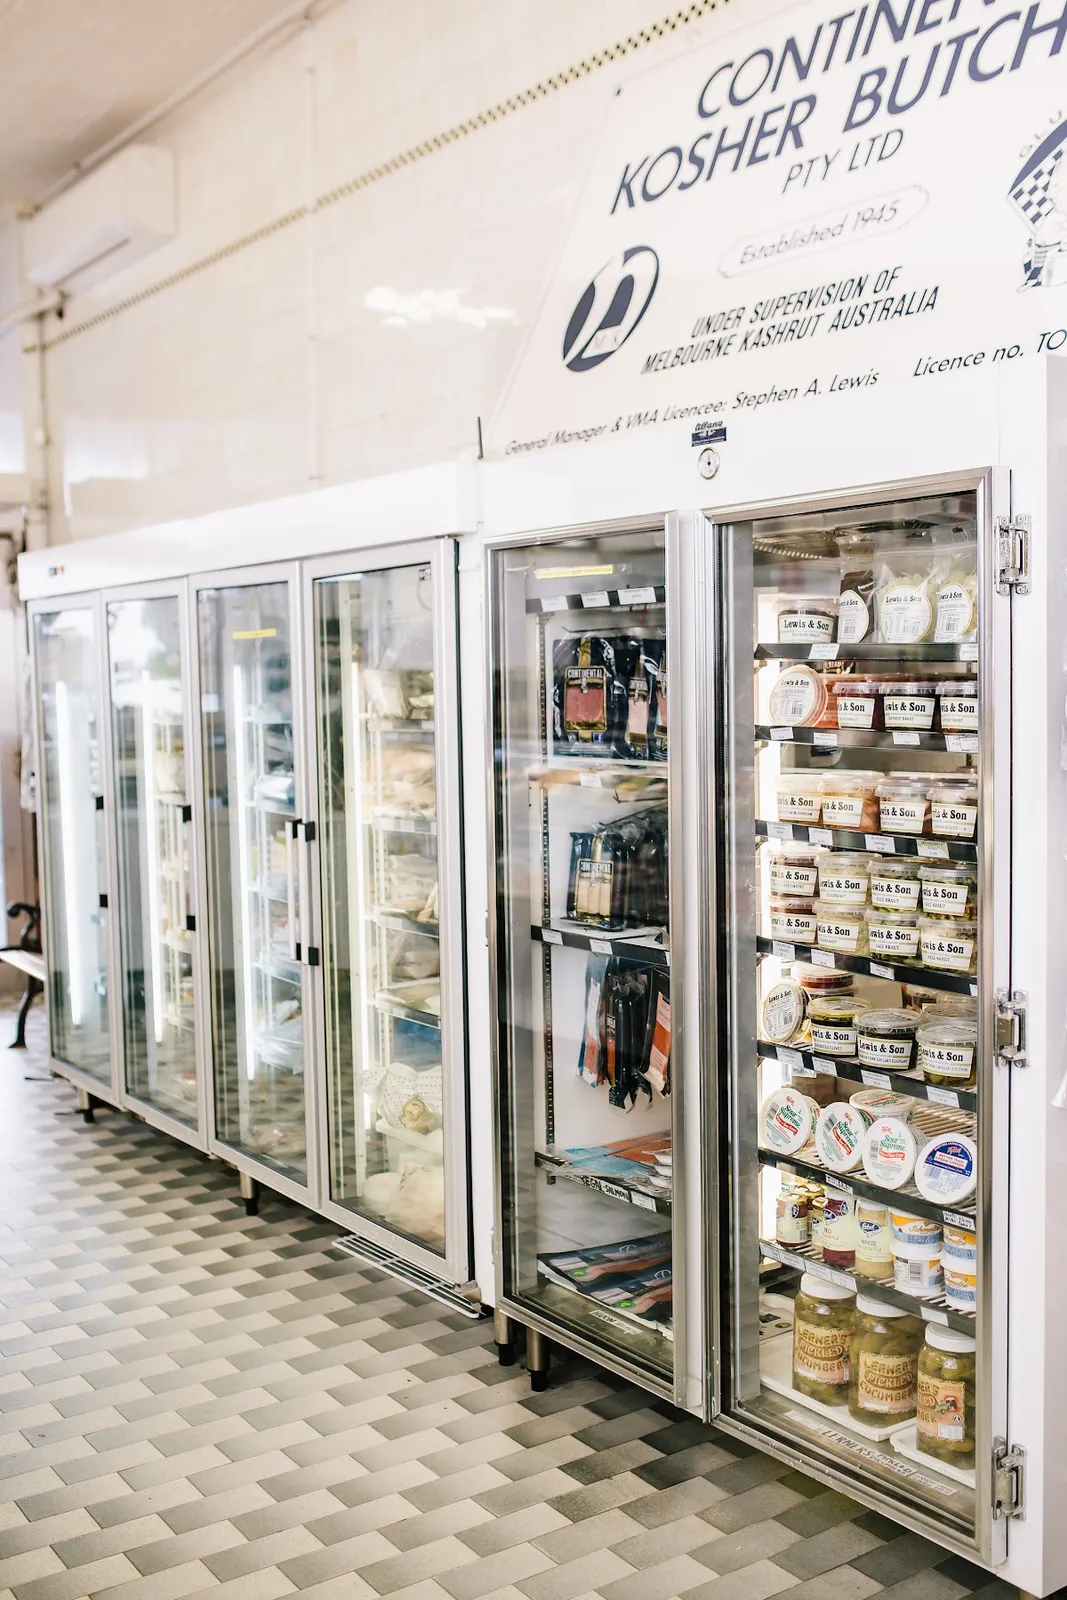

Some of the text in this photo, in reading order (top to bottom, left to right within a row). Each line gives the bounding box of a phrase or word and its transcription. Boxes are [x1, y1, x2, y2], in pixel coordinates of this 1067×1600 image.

[610, 93, 817, 215] KOSHER
[782, 129, 904, 194] PTY LTD
[739, 199, 900, 265] Established 1945
[690, 266, 902, 339] UNDER SUPERVISION OF
[640, 333, 738, 375] MELBOURNE
[738, 312, 826, 353] KASHRUT
[827, 285, 941, 333] AUSTRALIA
[913, 351, 985, 377] Licence
[992, 344, 1024, 362] no.
[505, 368, 881, 455] General Manager & VMA Licencee: Stephen A. Lewis
[783, 619, 830, 632] Lewis & Son
[843, 702, 865, 712] & Son
[900, 702, 907, 711] &
[909, 702, 926, 712] Son
[950, 703, 956, 712] &
[957, 703, 975, 713] Son
[790, 797, 796, 806] &
[798, 797, 814, 807] Son
[831, 801, 837, 810] &
[838, 802, 854, 812] Son
[891, 807, 897, 816] &
[899, 808, 916, 818] Son
[942, 809, 949, 819] &
[949, 809, 967, 820] Son
[785, 870, 792, 880] &
[794, 871, 810, 881] Son
[835, 879, 843, 889] &
[844, 879, 861, 890] Son
[885, 883, 893, 893] &
[894, 884, 911, 895] Son
[932, 888, 939, 898] &
[941, 888, 958, 899] Son
[786, 918, 793, 927] &
[794, 918, 810, 928] Son
[826, 924, 833, 934] &
[834, 926, 850, 936] Son
[885, 930, 893, 940] &
[894, 930, 911, 941] Son
[937, 941, 945, 952] &
[947, 942, 964, 955] Son
[825, 1030, 832, 1040] &
[833, 1030, 850, 1041] Son
[858, 1038, 905, 1054] Lewis & Son
[936, 1050, 945, 1060] &
[946, 1050, 964, 1062] Son
[779, 1106, 801, 1128] Supreme
[784, 1104, 798, 1118] Sour
[836, 1121, 855, 1148] Supreme
[842, 1121, 854, 1136] Sour
[884, 1134, 898, 1144] Sour
[879, 1140, 906, 1151] Supreme
[798, 1325, 848, 1346] LERNER'S
[798, 1340, 843, 1359] PICKLED
[865, 1371, 914, 1389] PICKLED
